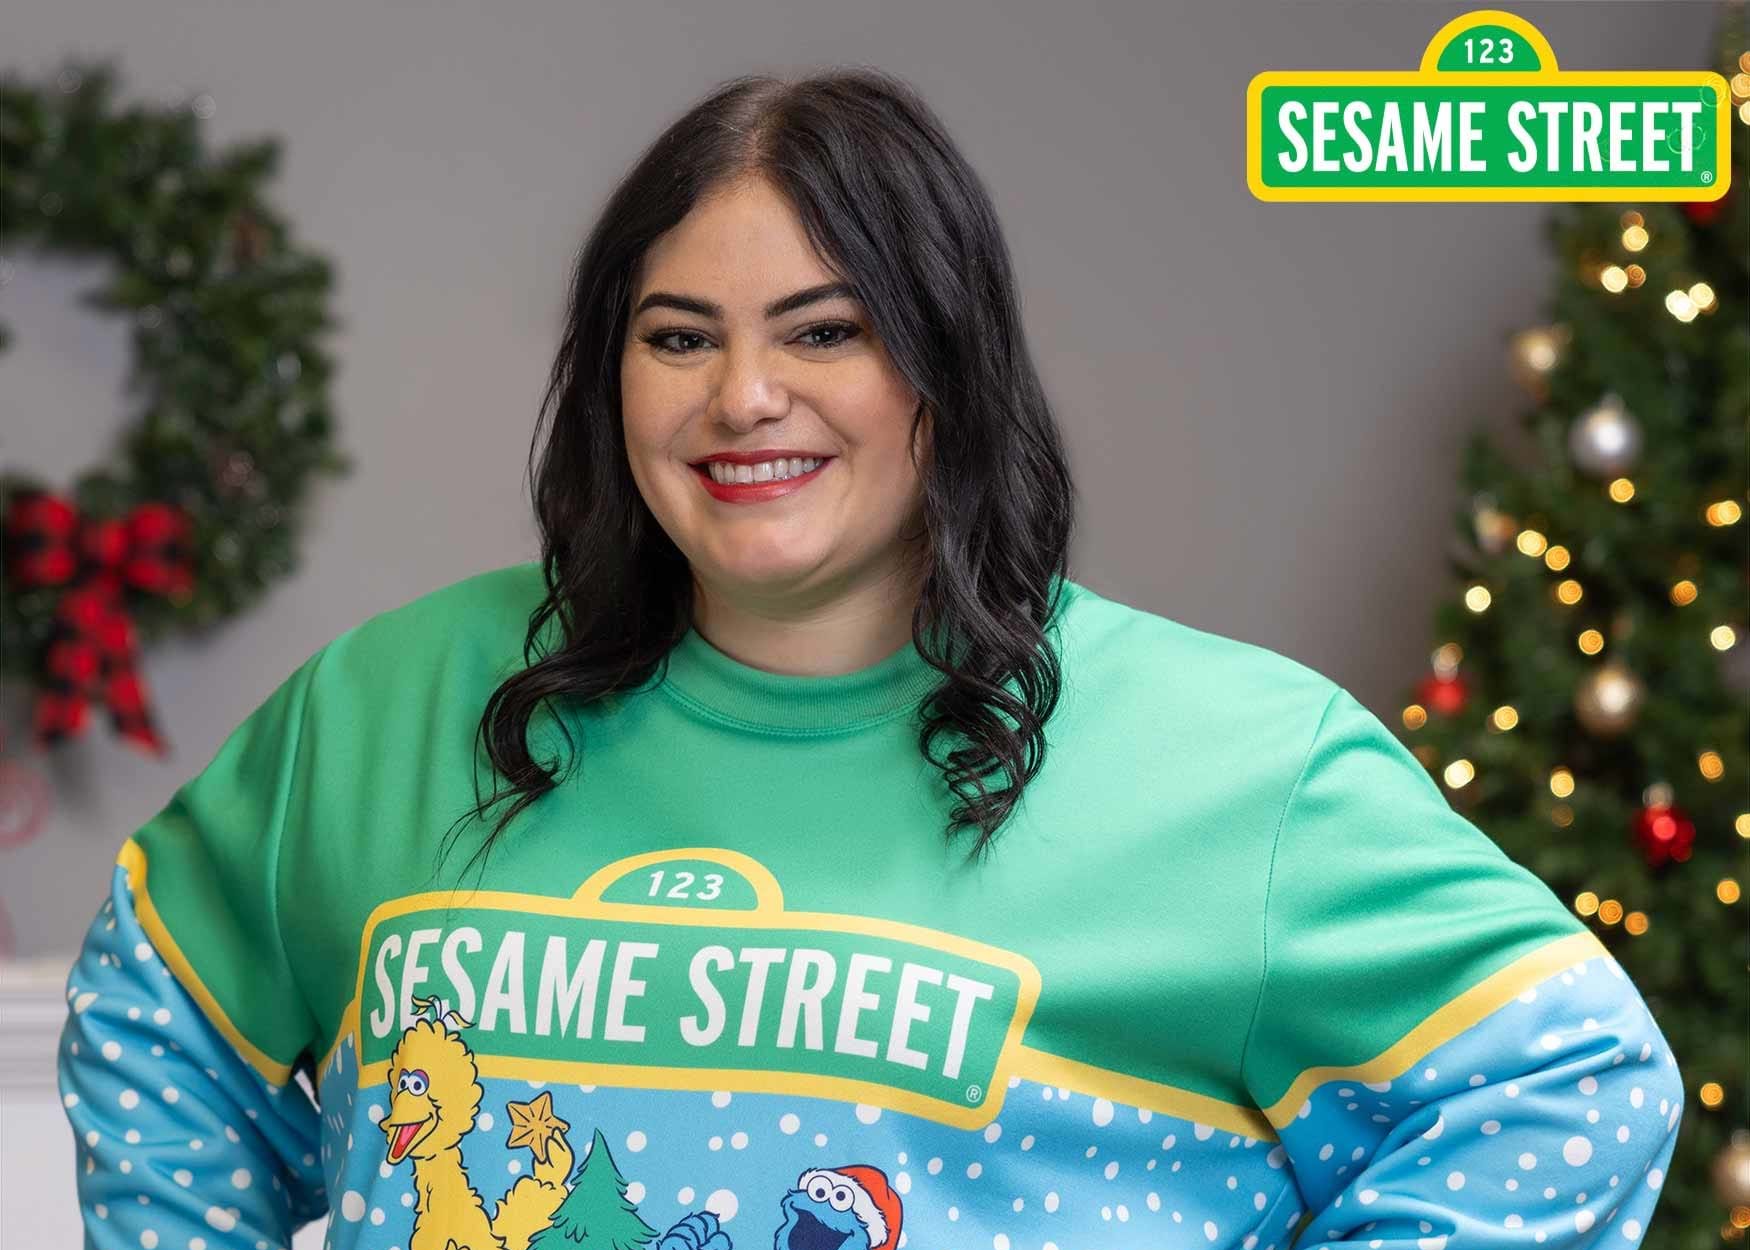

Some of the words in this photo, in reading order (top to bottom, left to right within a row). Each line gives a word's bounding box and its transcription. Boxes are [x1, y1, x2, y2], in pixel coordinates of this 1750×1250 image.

[647, 870, 724, 901] 123
[370, 926, 659, 1043] SESAME
[679, 945, 995, 1080] STREET
